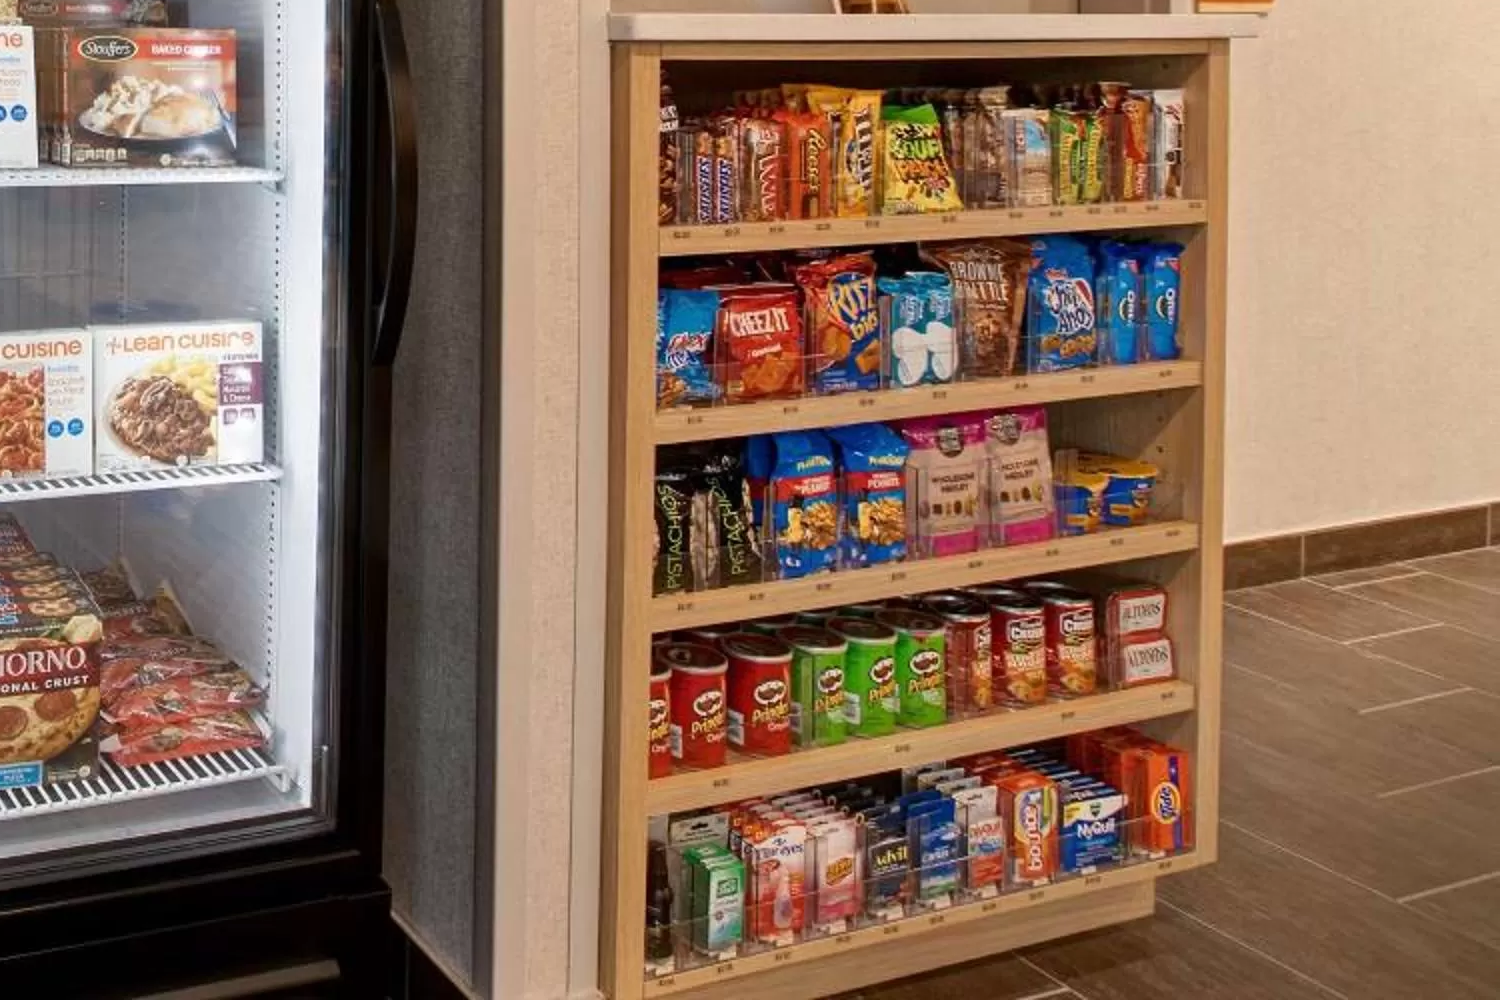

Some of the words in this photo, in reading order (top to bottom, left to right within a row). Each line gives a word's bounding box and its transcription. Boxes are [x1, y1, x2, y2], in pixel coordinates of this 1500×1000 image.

[85, 39, 132, 58] Stouffer's
[151, 43, 182, 55] BAKED
[1, 338, 83, 361] cuisine
[178, 330, 255, 350] cuisine
[658, 484, 684, 589] PISTACHIOS
[45, 675, 90, 690] CRUST
[1076, 817, 1116, 839] NyQuil
